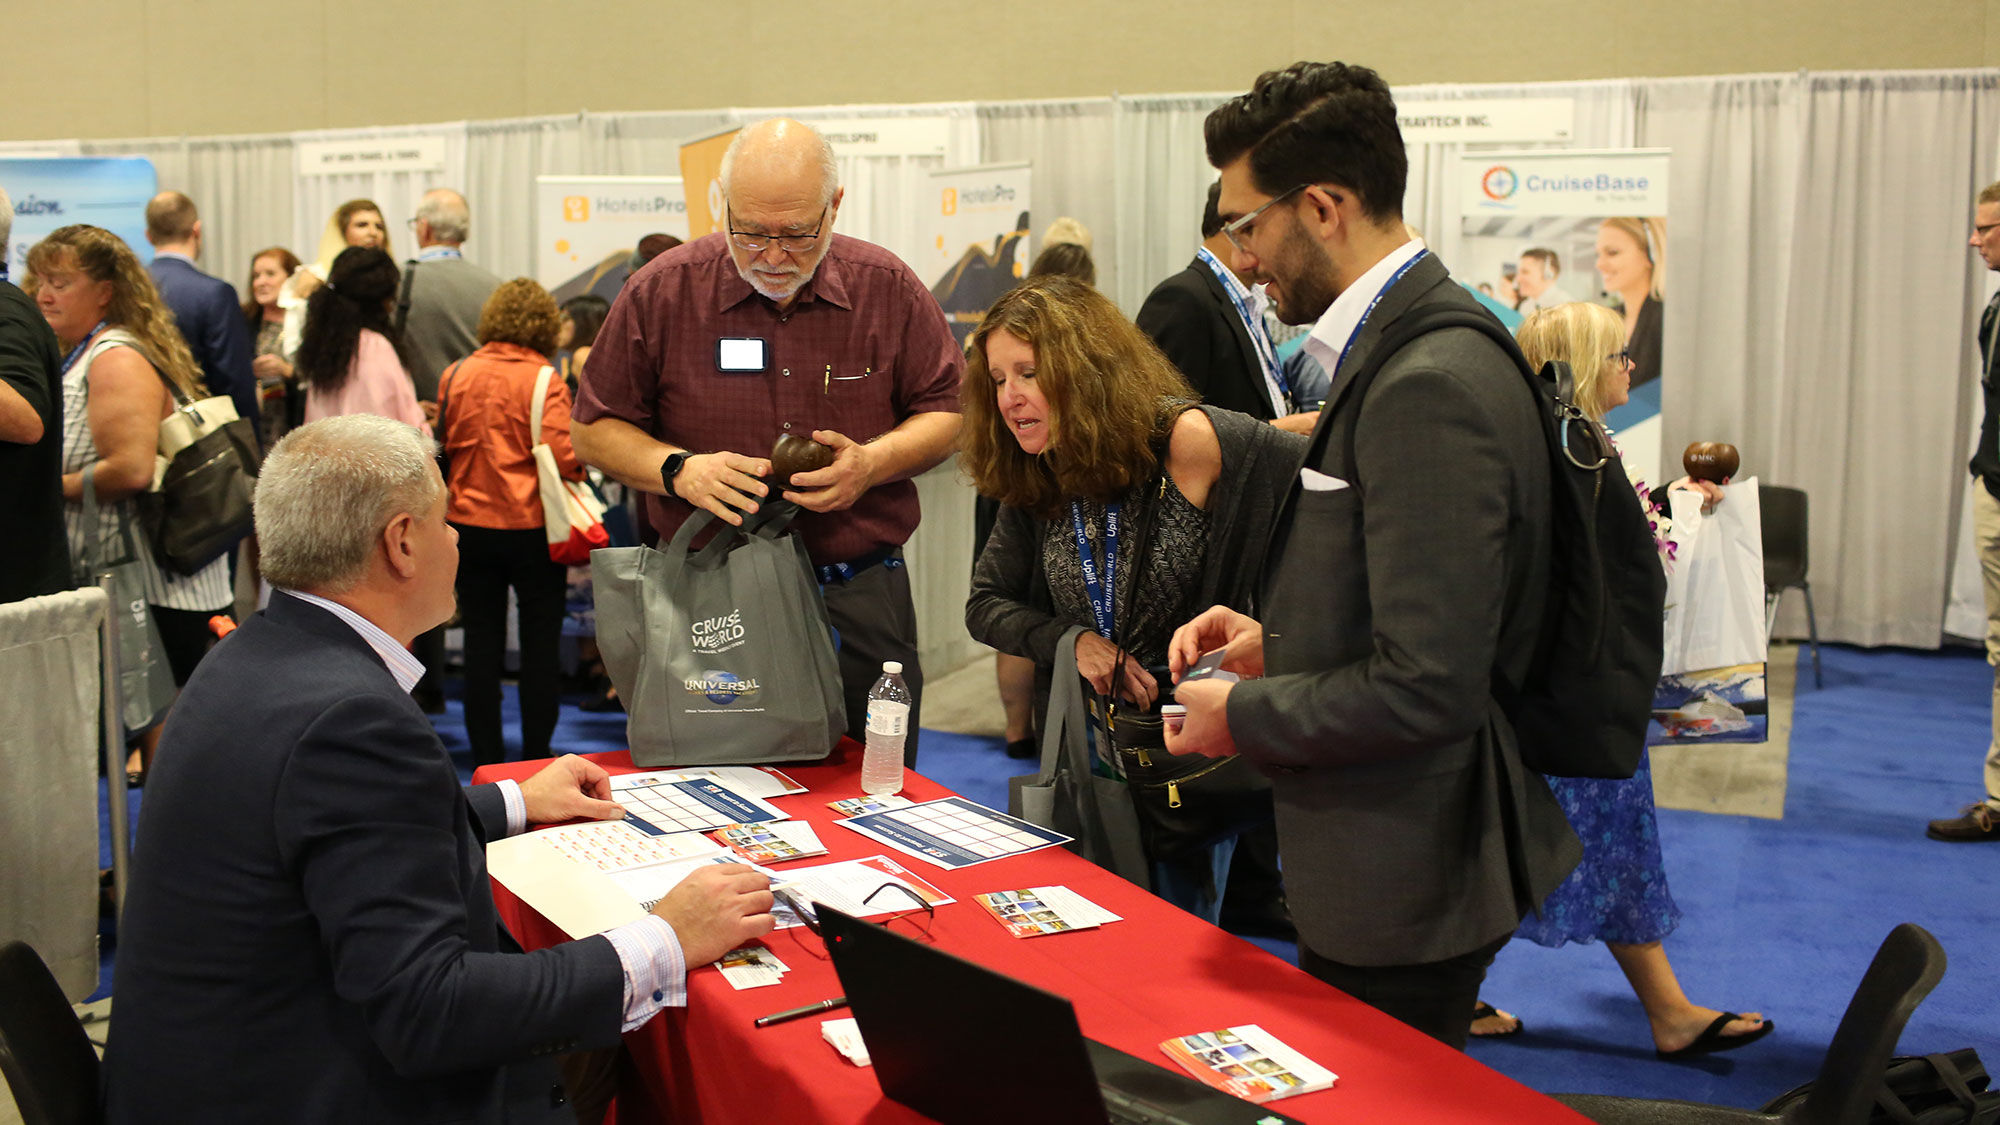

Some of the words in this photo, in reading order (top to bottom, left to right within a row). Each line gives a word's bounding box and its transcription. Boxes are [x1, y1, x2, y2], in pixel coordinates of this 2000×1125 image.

[1466, 115, 1491, 127] INC.
[825, 132, 877, 143] OTELSPRO
[1526, 173, 1649, 192] CruiseBase
[961, 184, 1015, 204] HotelsPro
[14, 194, 64, 216] sion
[597, 196, 687, 214] HotelsPro
[1107, 512, 1118, 537] Uplift
[1082, 559, 1097, 585] Uplift
[692, 608, 741, 635] CRUISE
[692, 624, 745, 648] WORLD
[684, 678, 760, 691] UNIVERSAL
